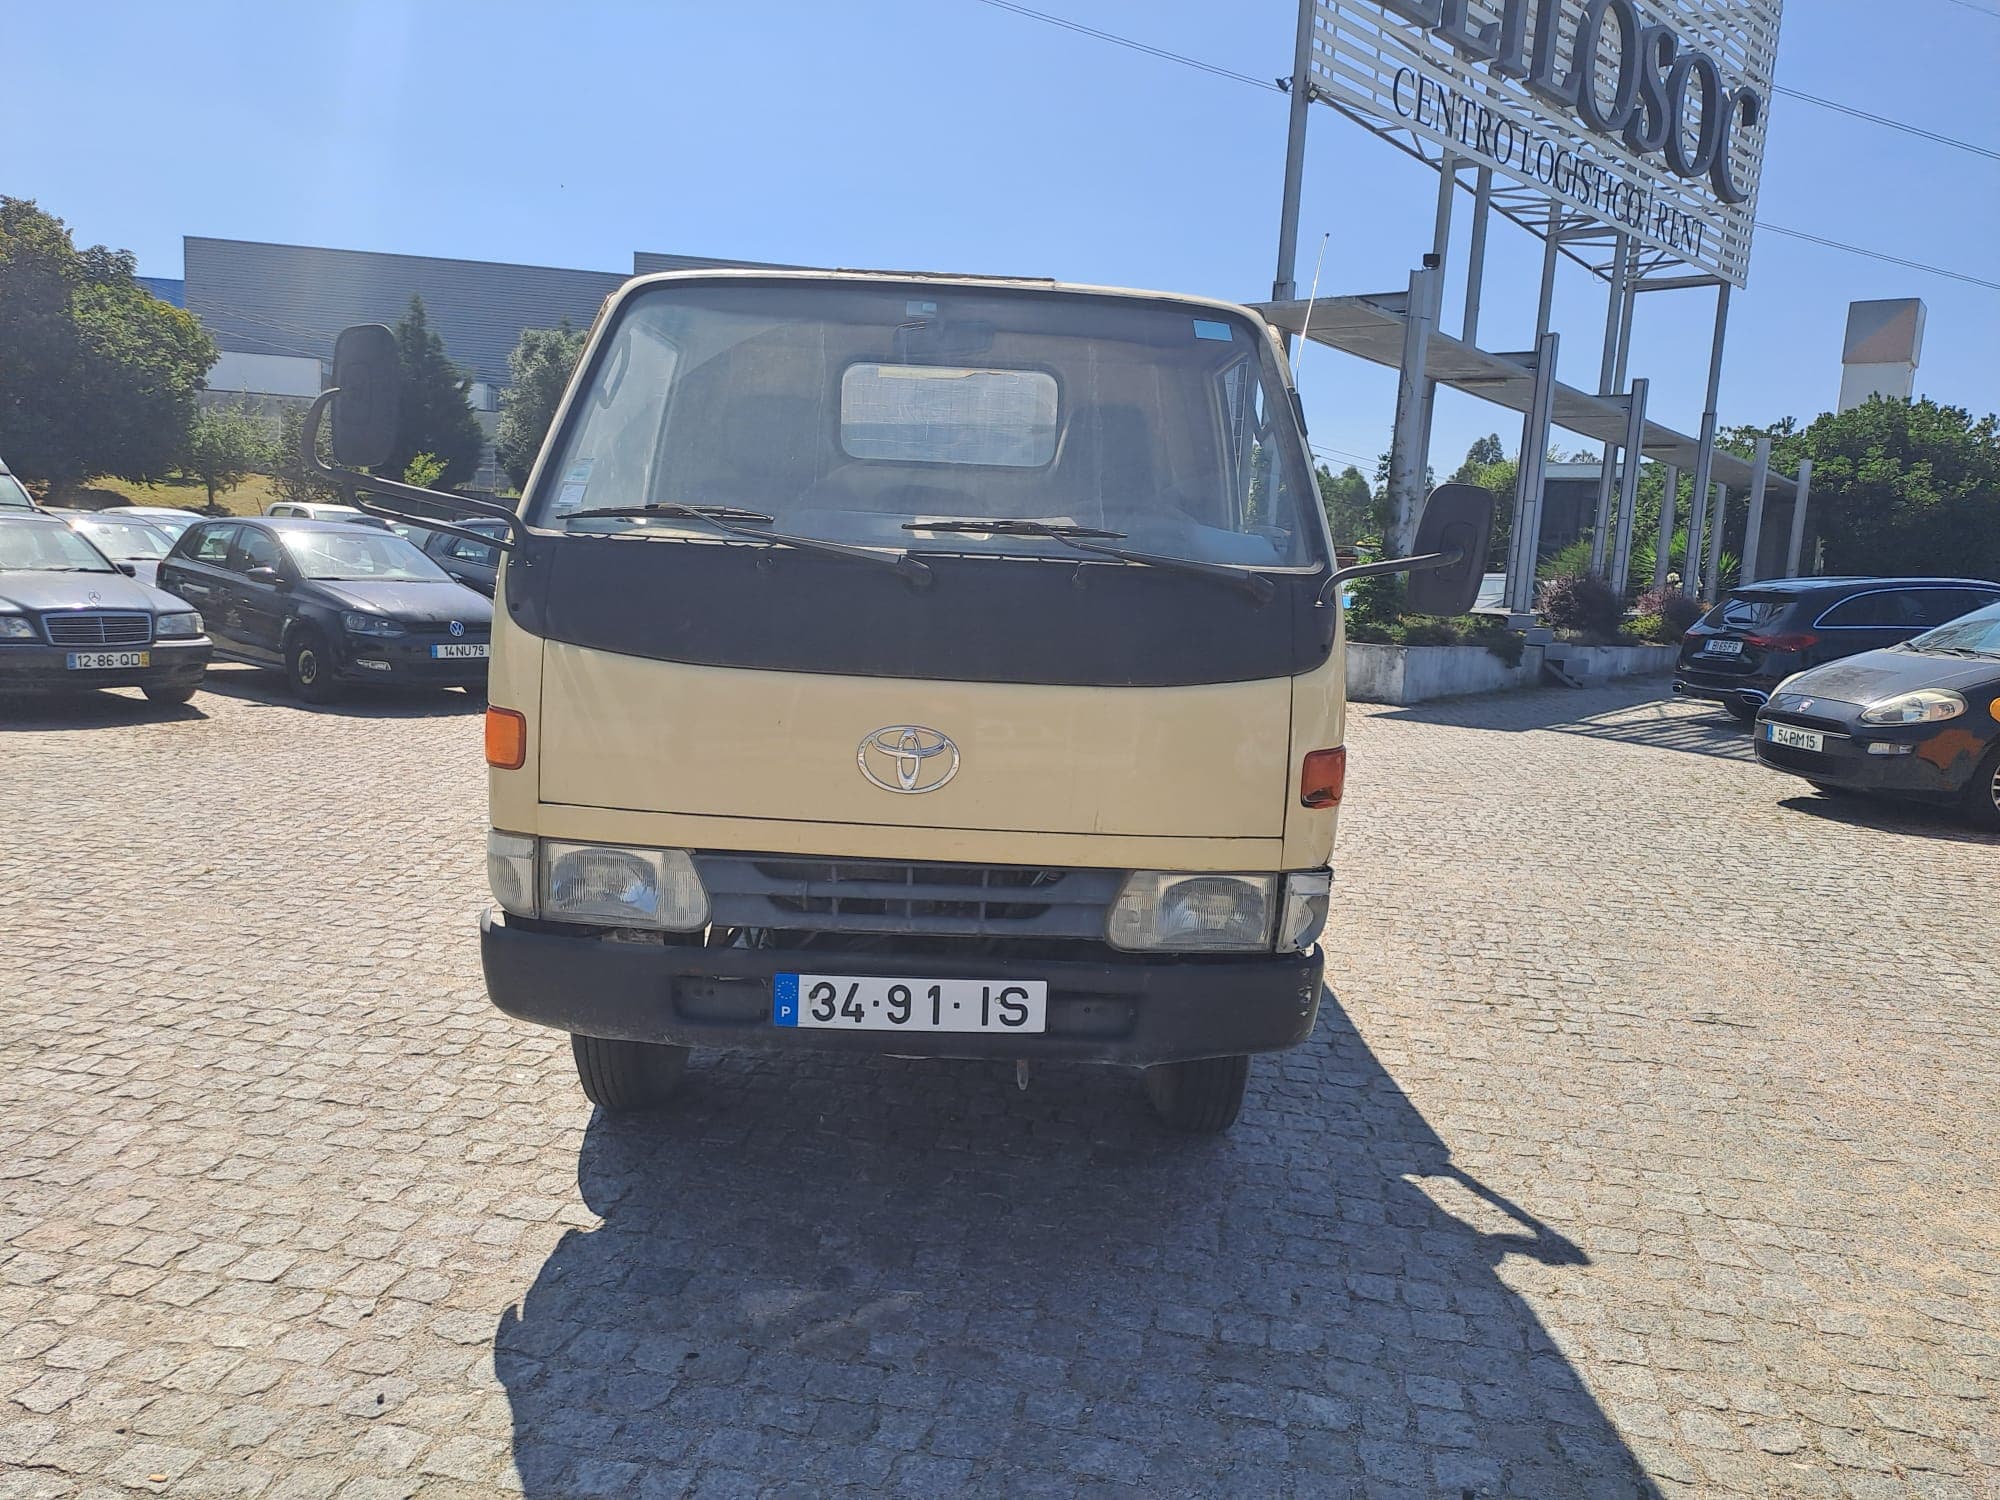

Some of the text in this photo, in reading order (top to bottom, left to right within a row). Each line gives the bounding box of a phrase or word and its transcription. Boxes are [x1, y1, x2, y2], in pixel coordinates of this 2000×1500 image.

[1393, 67, 1513, 165] CENTRO
[1656, 202, 1707, 258] RENT
[781, 1005, 791, 1017] P
